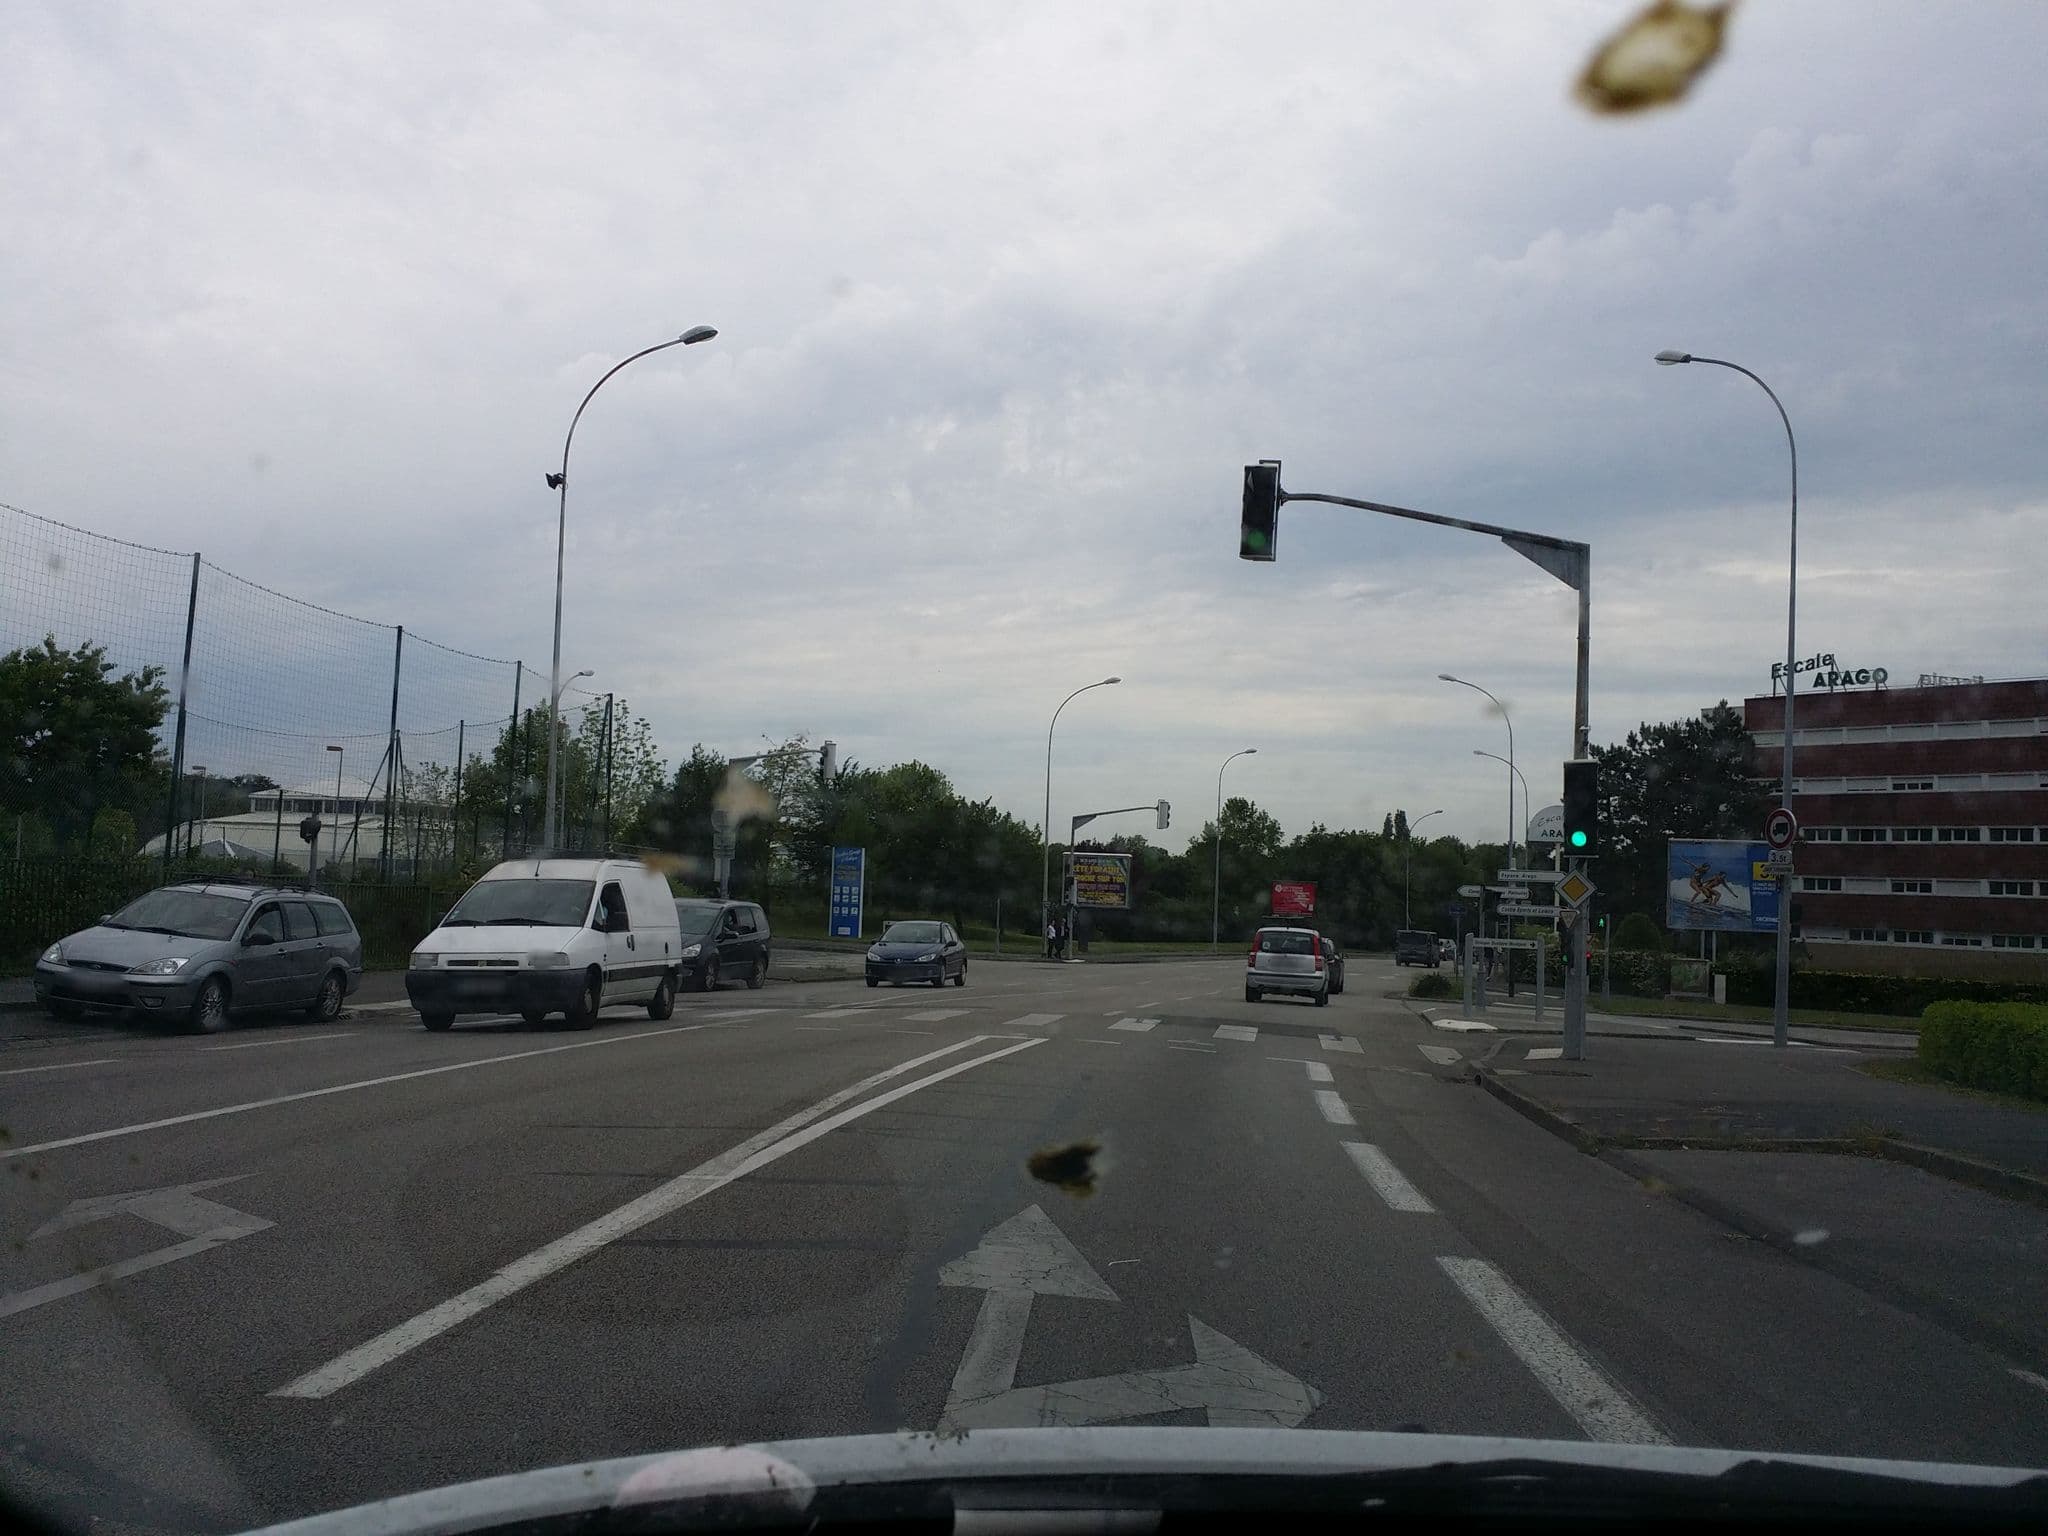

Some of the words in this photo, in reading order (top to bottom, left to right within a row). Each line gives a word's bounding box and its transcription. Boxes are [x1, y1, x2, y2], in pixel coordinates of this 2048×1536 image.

[1771, 653, 1833, 679] Escale
[1813, 667, 1888, 688] ARAGO
[1537, 816, 1561, 827] Esca
[1541, 829, 1563, 838] ARA
